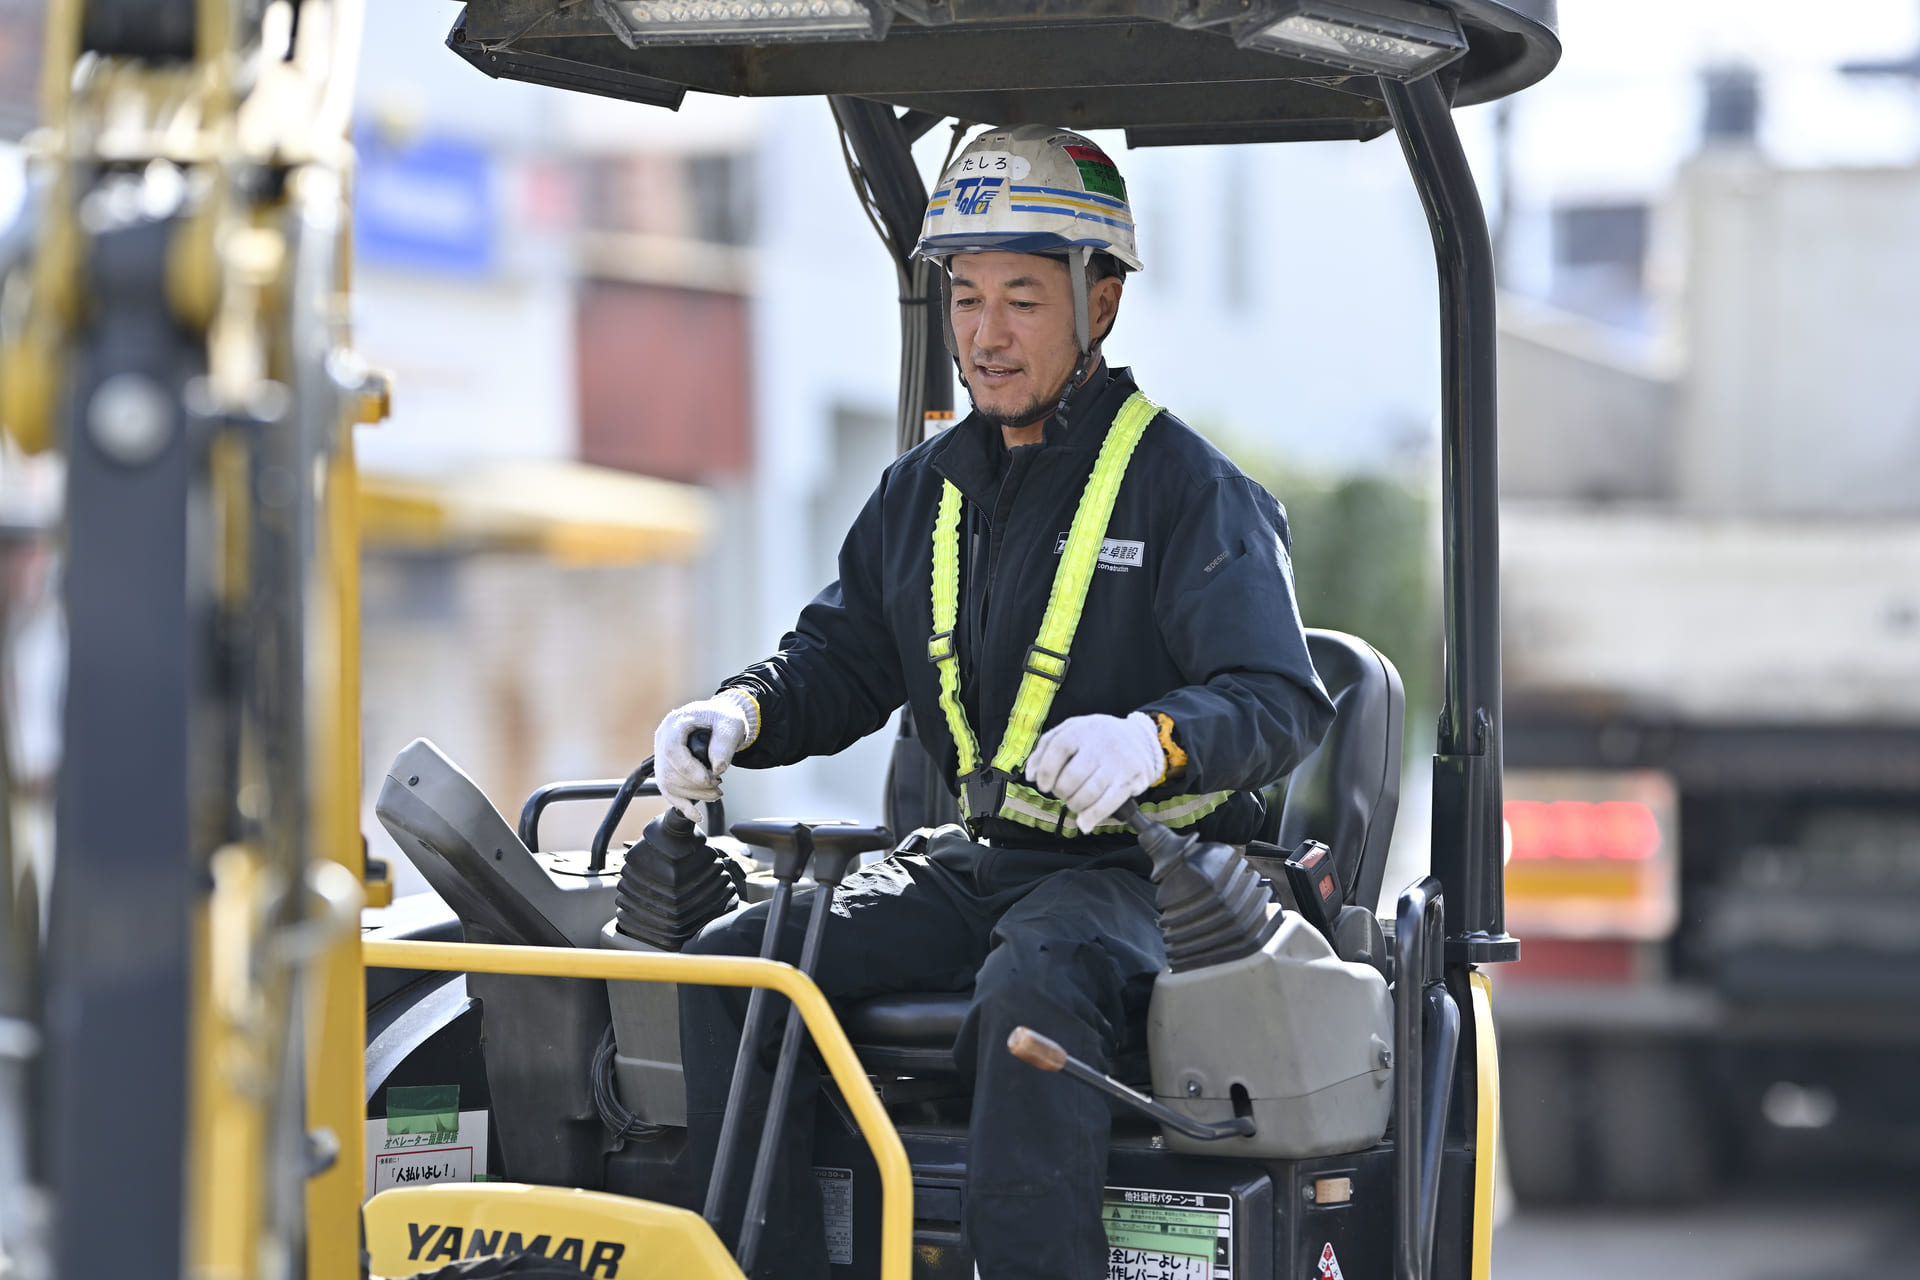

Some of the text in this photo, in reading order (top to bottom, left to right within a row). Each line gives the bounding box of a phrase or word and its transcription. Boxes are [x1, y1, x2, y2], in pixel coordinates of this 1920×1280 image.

[962, 155, 1007, 171] たしろ
[1124, 1191, 1205, 1207] 他社操作パターン一覧
[407, 1222, 625, 1280] YANMAR
[1107, 1248, 1201, 1273] 全レバーよし！」
